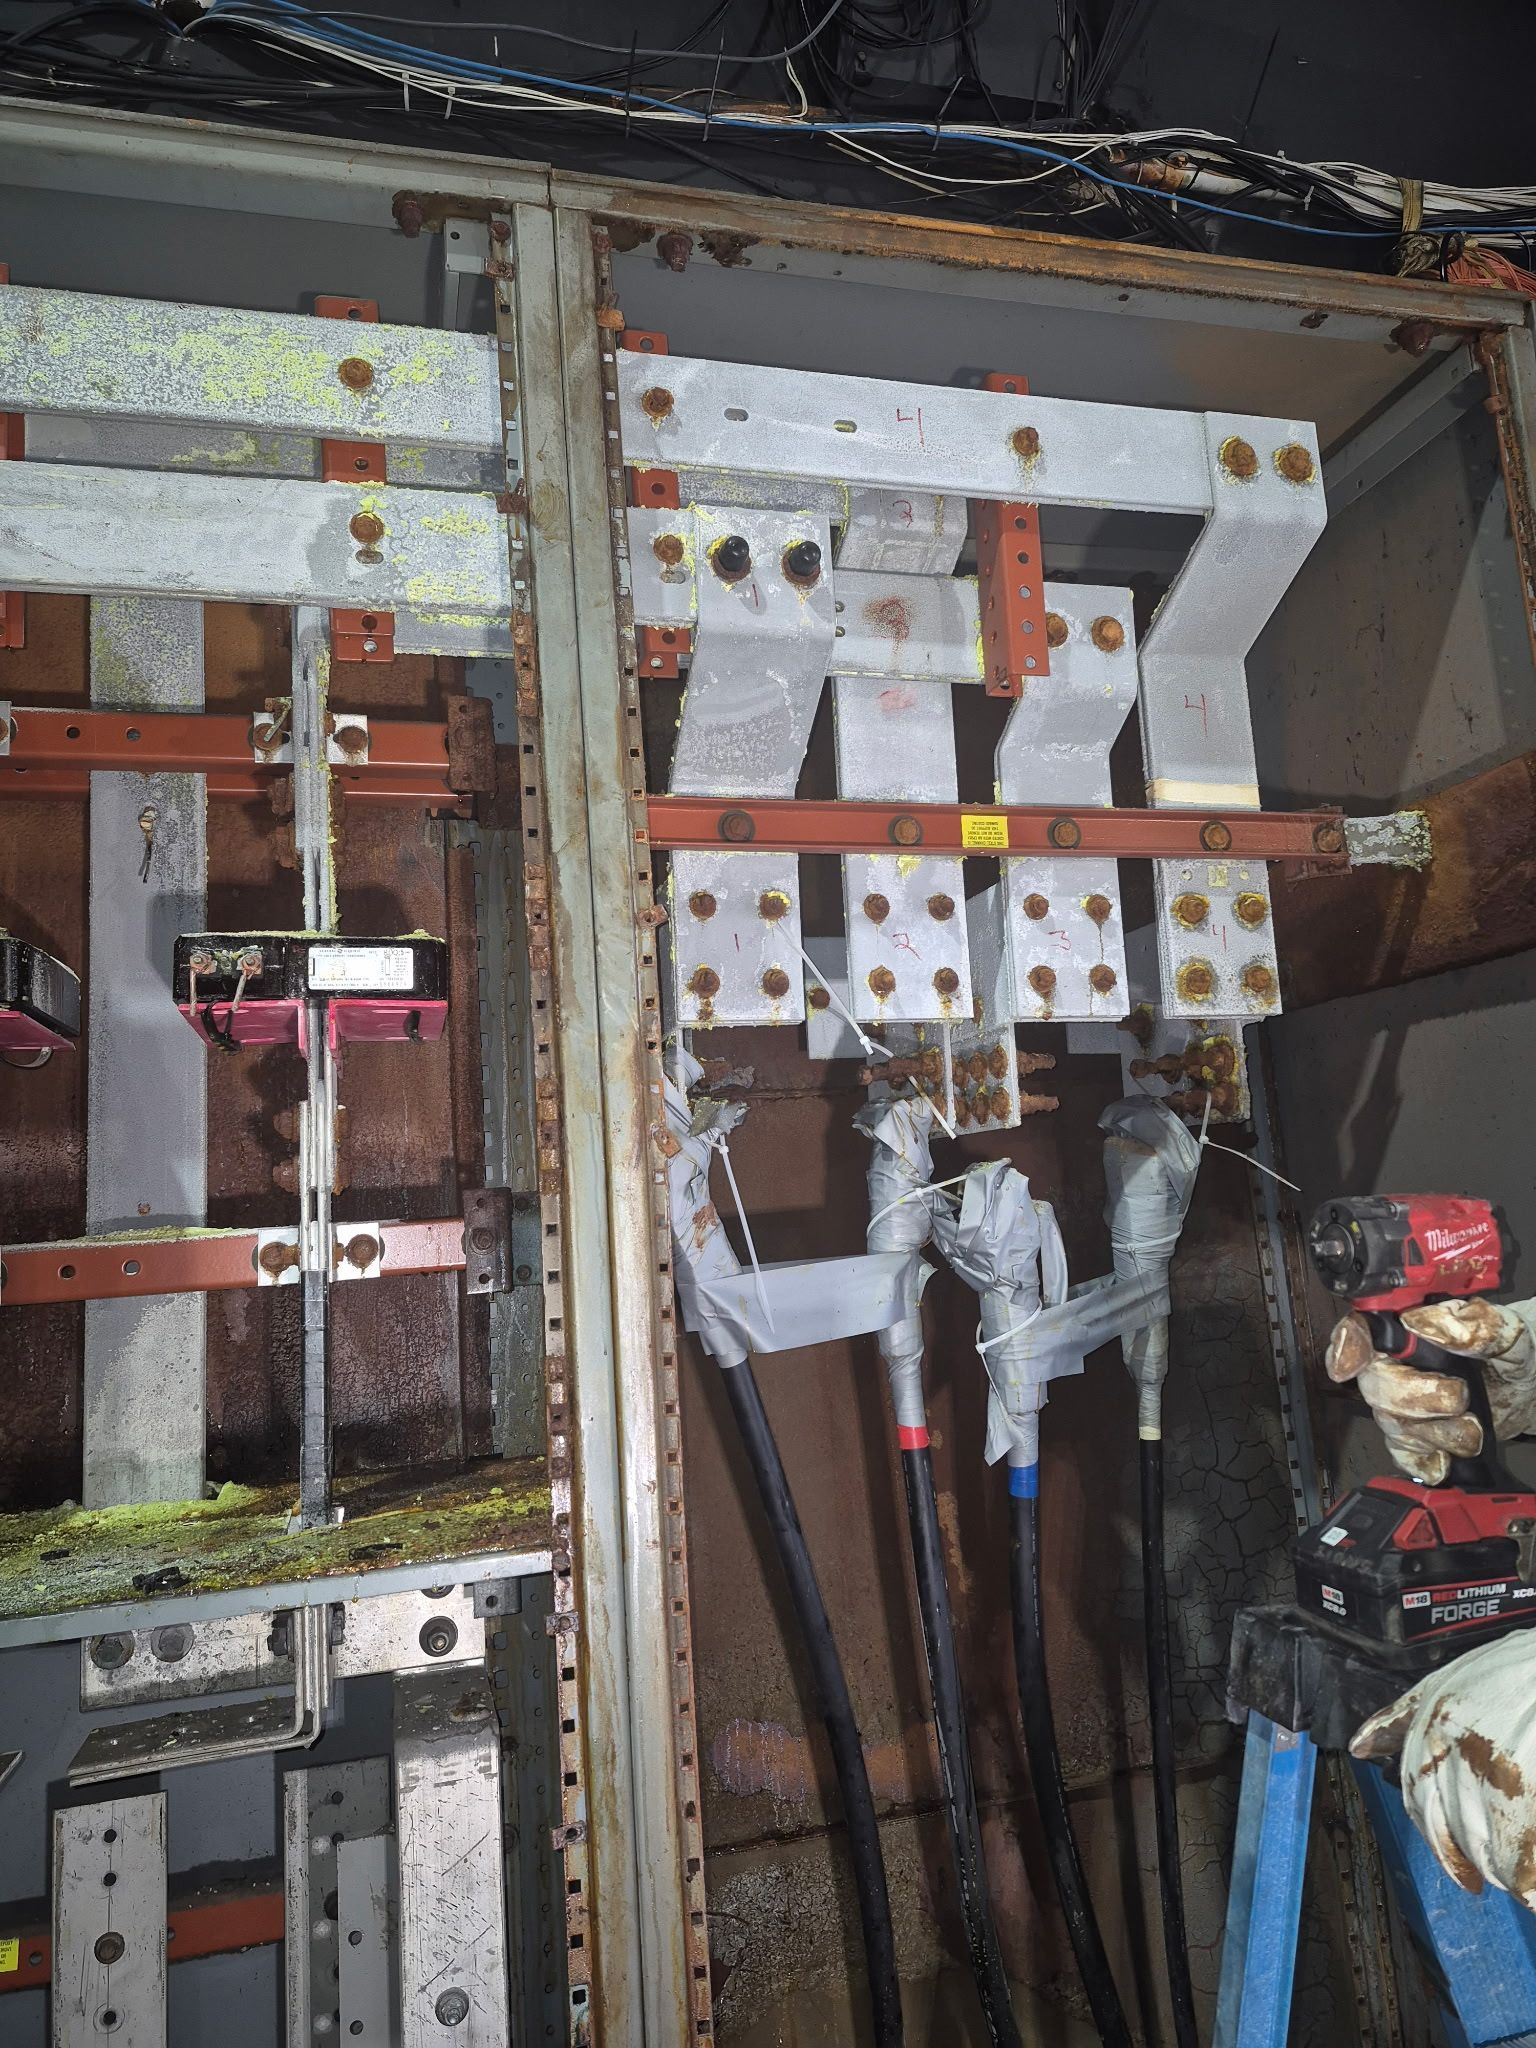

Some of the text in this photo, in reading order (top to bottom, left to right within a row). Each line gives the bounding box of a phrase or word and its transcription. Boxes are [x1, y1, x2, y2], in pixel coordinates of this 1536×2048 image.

[896, 407, 925, 447] 4
[1184, 693, 1208, 737] 4
[893, 932, 922, 961] 2
[1047, 929, 1072, 951] 3
[1212, 924, 1227, 950] 4
[1403, 1594, 1429, 1607] M18
[1431, 1599, 1500, 1624] FORGE
